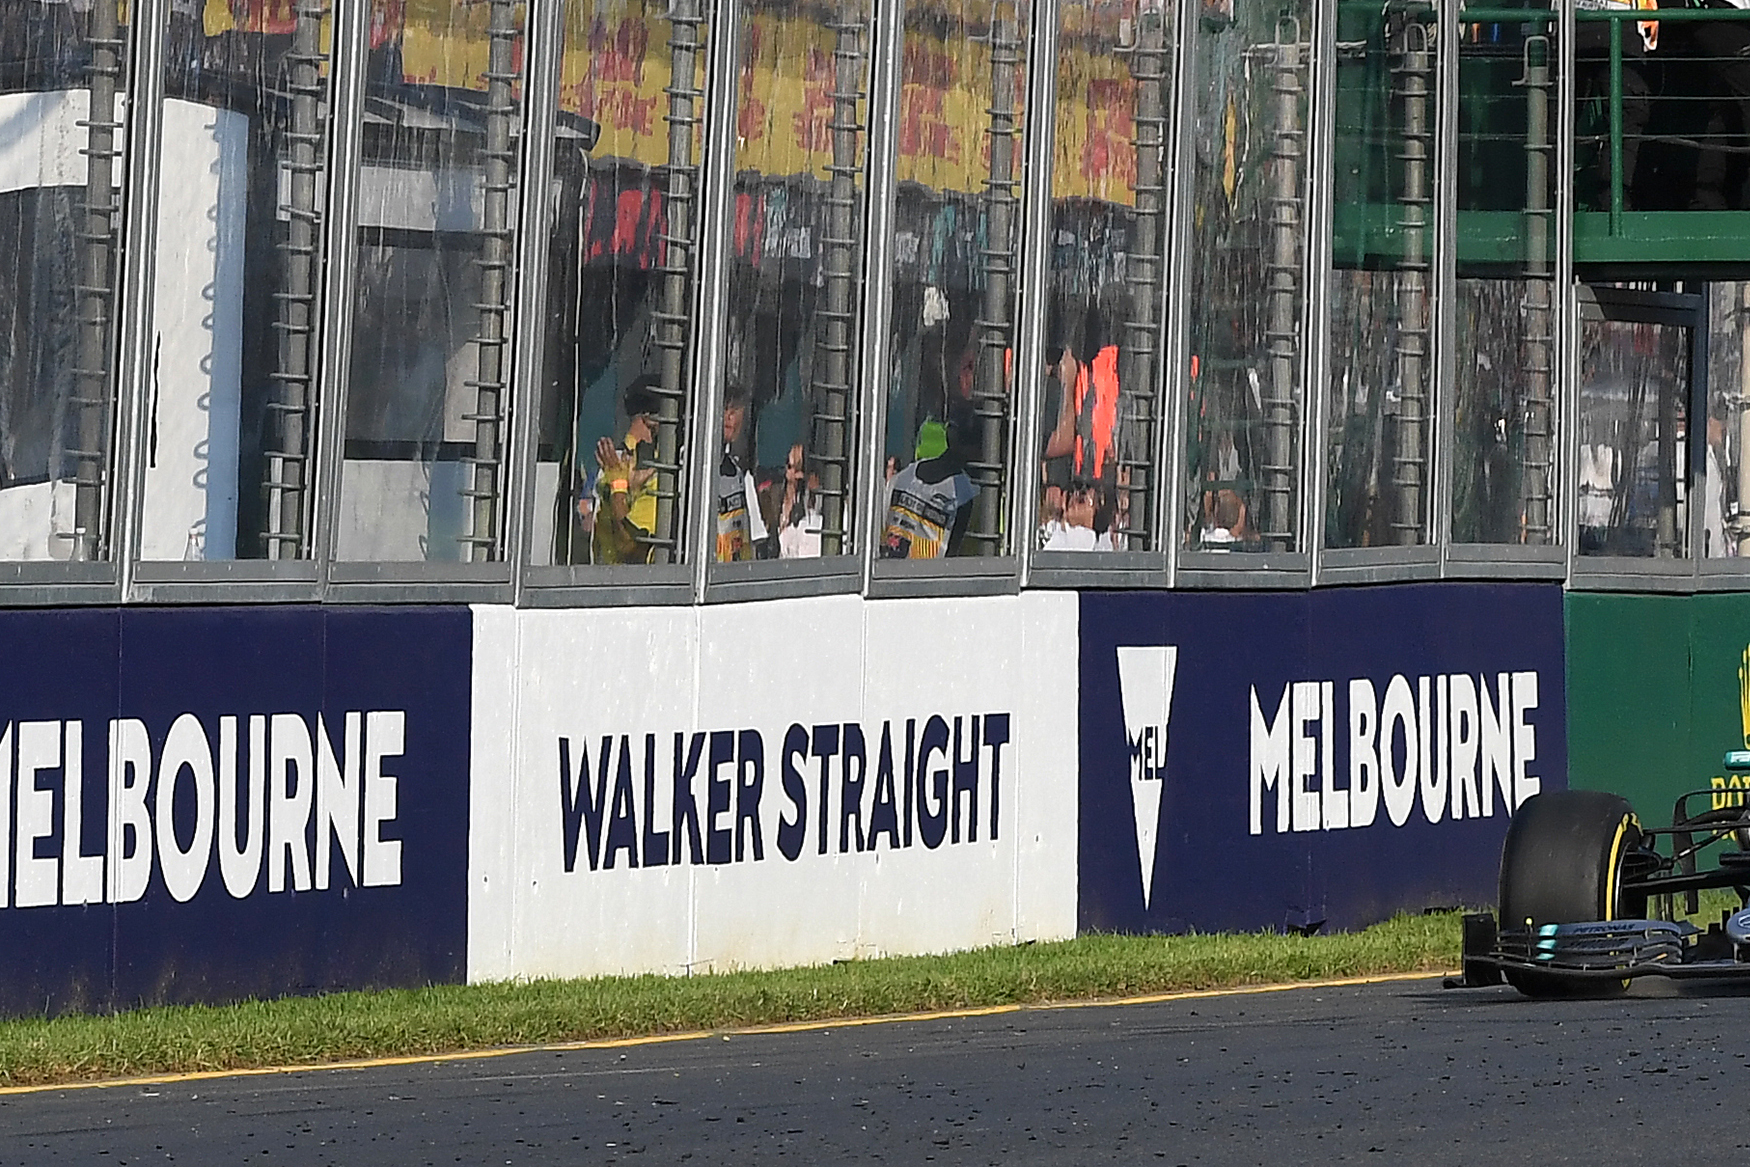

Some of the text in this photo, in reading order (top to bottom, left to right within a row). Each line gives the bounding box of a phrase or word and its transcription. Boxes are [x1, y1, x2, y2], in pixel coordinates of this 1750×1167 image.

[558, 712, 1010, 875] WALKER STRAIGHT
[1128, 670, 1541, 836] MEL MELBOURNE
